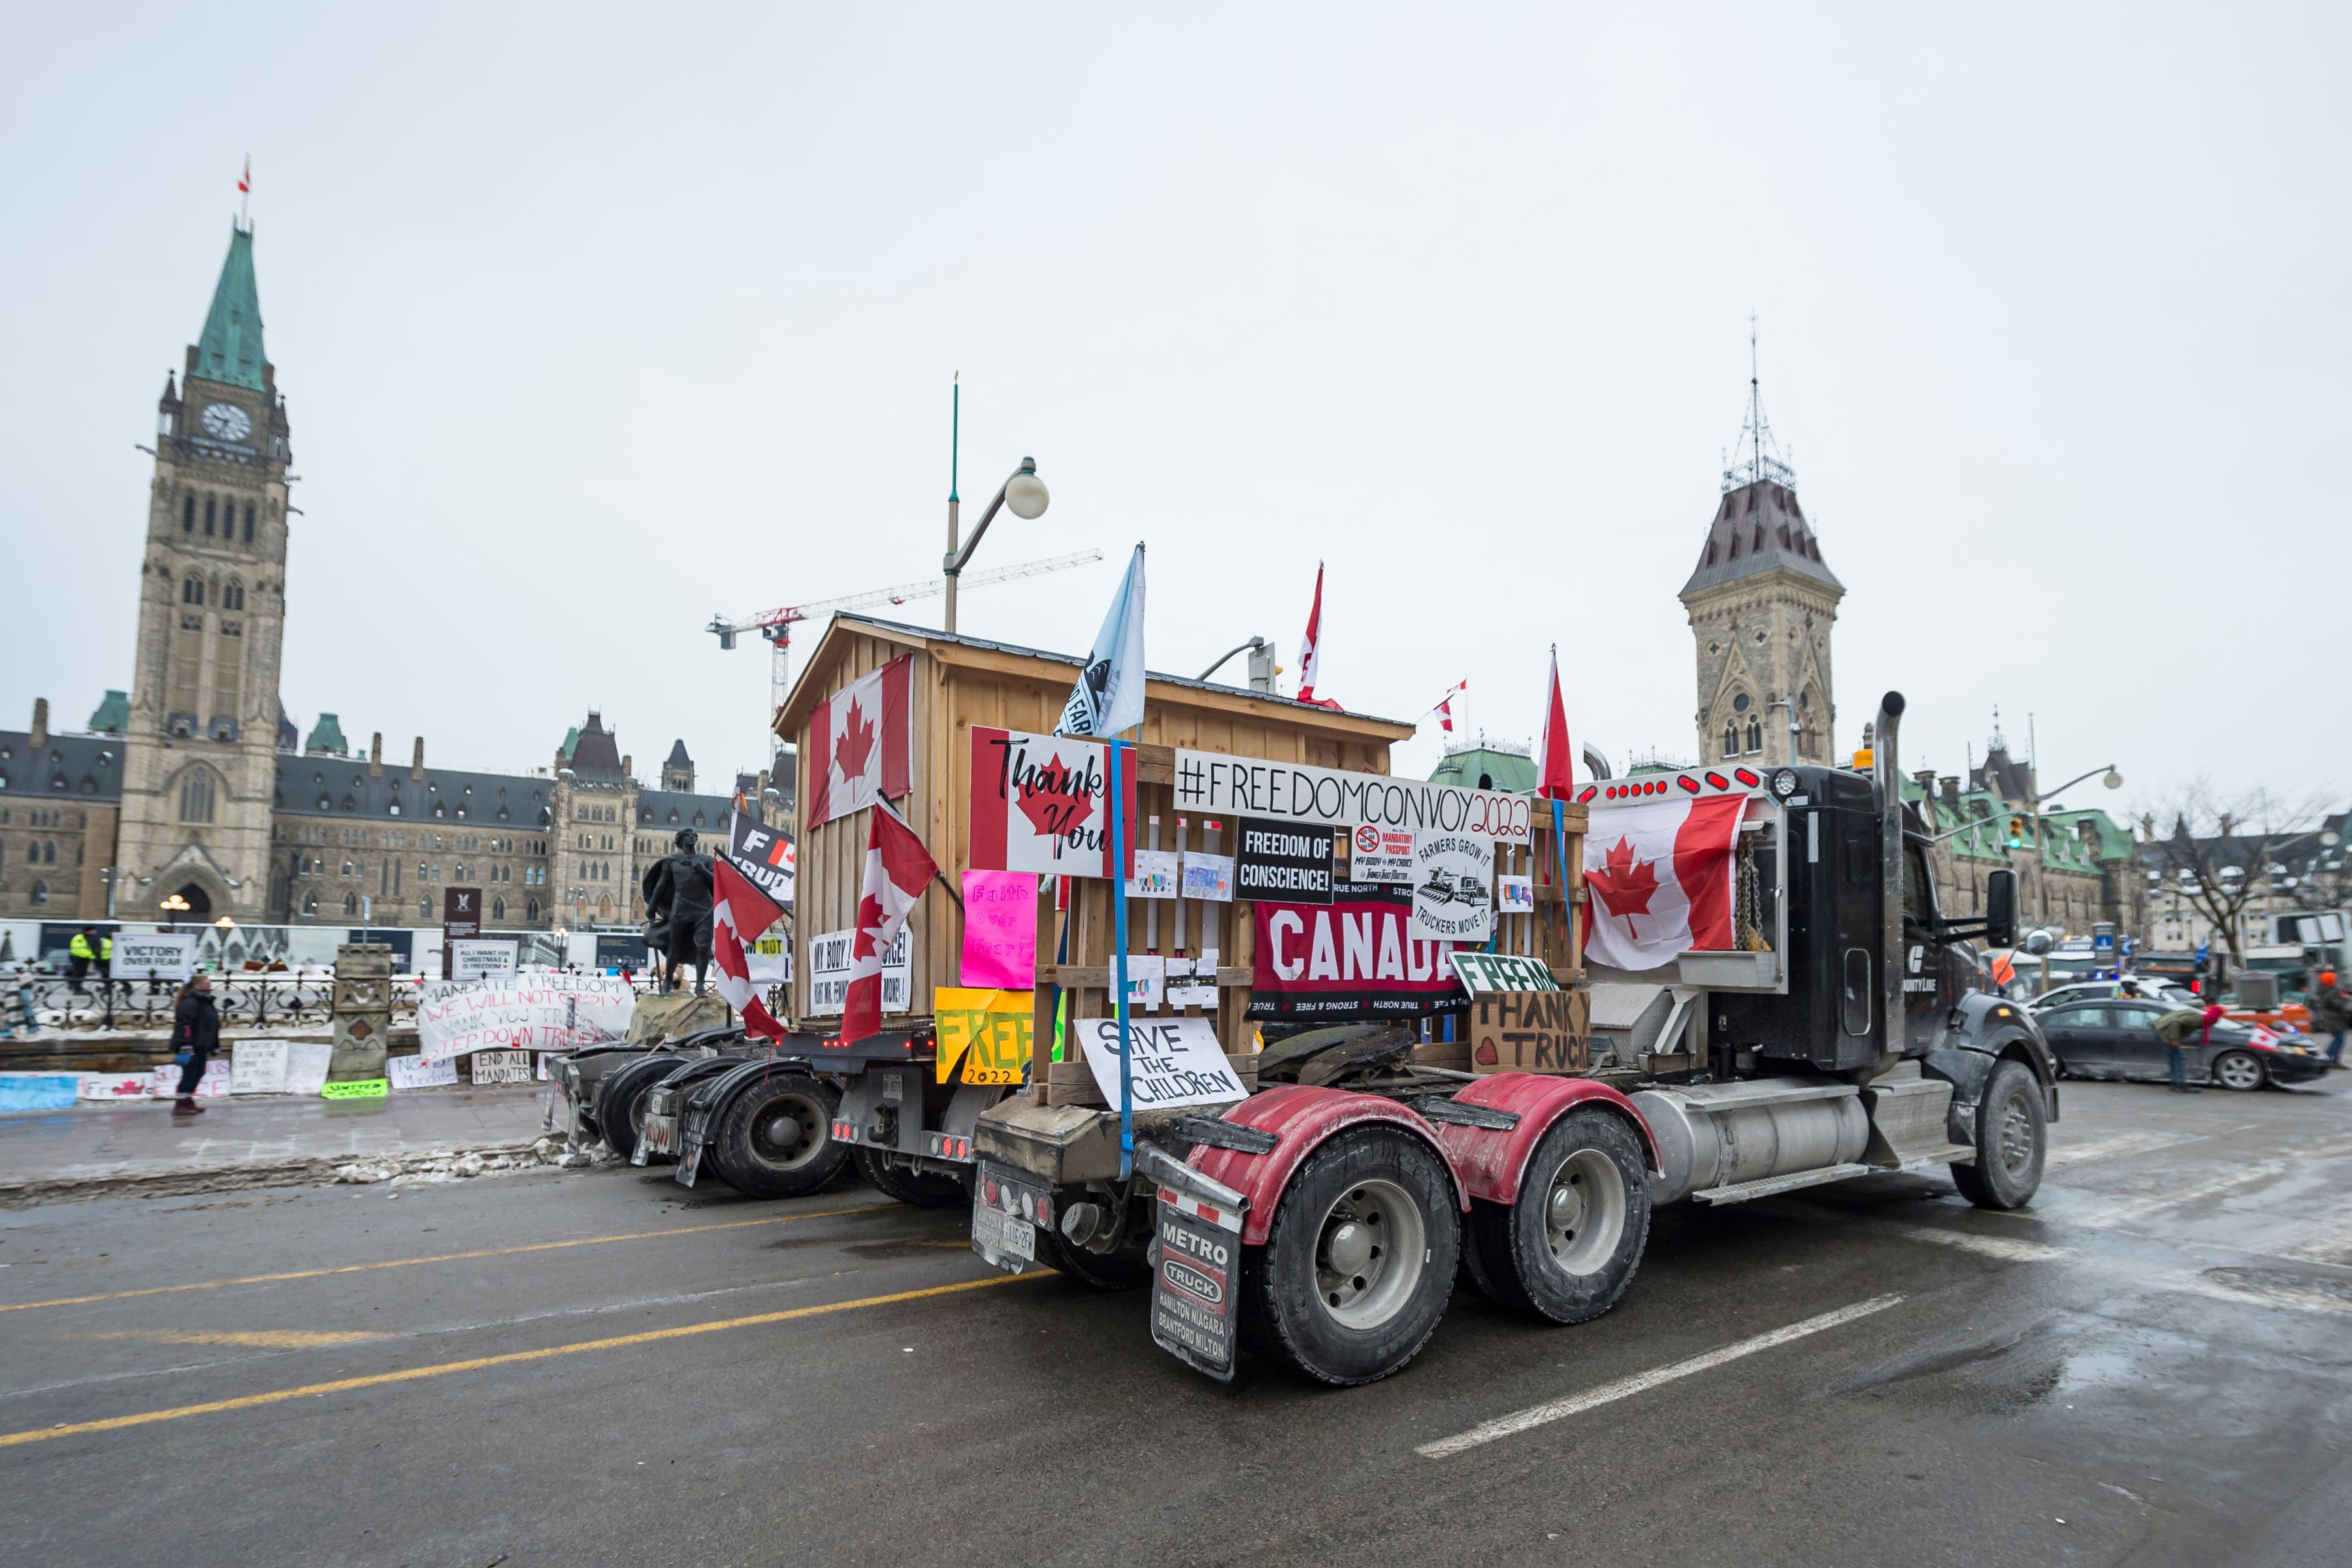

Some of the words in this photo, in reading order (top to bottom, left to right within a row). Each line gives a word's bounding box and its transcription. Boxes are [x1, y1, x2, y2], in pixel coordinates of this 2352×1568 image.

[1068, 699, 1093, 736] FAR
[990, 738, 1109, 804] Thank
[1043, 804, 1115, 860] You
[1382, 833, 1413, 843] MANDATORY
[1245, 830, 1311, 857] FREEDOM
[1313, 838, 1330, 859] OF
[1386, 845, 1410, 855] PASSPORT
[1419, 838, 1456, 863] FARMERS
[1459, 839, 1482, 860] GROW
[1480, 853, 1490, 867] IT
[1354, 857, 1365, 866] MY
[1365, 857, 1382, 866] BODY
[1387, 858, 1396, 867] MY
[1396, 858, 1413, 867] CHOICE
[1240, 864, 1329, 892] CONSCIENCE!
[1333, 883, 1349, 893] RUE
[1351, 883, 1378, 893] NORTH
[1392, 887, 1413, 897] STRO
[972, 885, 1028, 902] Faith
[1416, 906, 1456, 934] TRUCKERS
[1459, 915, 1480, 934] MOVE
[1479, 909, 1488, 923] IT
[123, 945, 183, 956] VICTORY
[762, 939, 781, 954] NOT
[815, 943, 824, 971] MY
[827, 939, 846, 969] BODY
[1269, 909, 1461, 981] CANADA
[123, 957, 151, 966] OVER
[154, 957, 180, 966] FEAR
[425, 999, 462, 1022] WE
[466, 992, 513, 1011] WILL
[518, 990, 554, 1004] NOT
[1252, 1002, 1275, 1011] TRUE
[1296, 1002, 1316, 1011] FREE
[1326, 1001, 1358, 1010] STRONG
[1373, 1000, 1399, 1009] NORTH
[1473, 991, 1575, 1033] THANK
[483, 1026, 533, 1046] DOWN
[1097, 1021, 1189, 1056] SAVE
[480, 1052, 502, 1066] END
[509, 1052, 528, 1065] ALL
[1133, 1056, 1179, 1074] THE
[475, 1067, 529, 1083] MANDATES
[968, 1069, 1012, 1083] 2022
[1131, 1070, 1237, 1103] CHILDREN
[1162, 1221, 1228, 1266] METRO
[1169, 1265, 1214, 1297] TRUCK
[1160, 1291, 1190, 1321] HAMILTON
[1191, 1309, 1225, 1337] NIAGARA
[1158, 1311, 1194, 1345] BRANTFORD
[1196, 1332, 1224, 1359] MILTON
